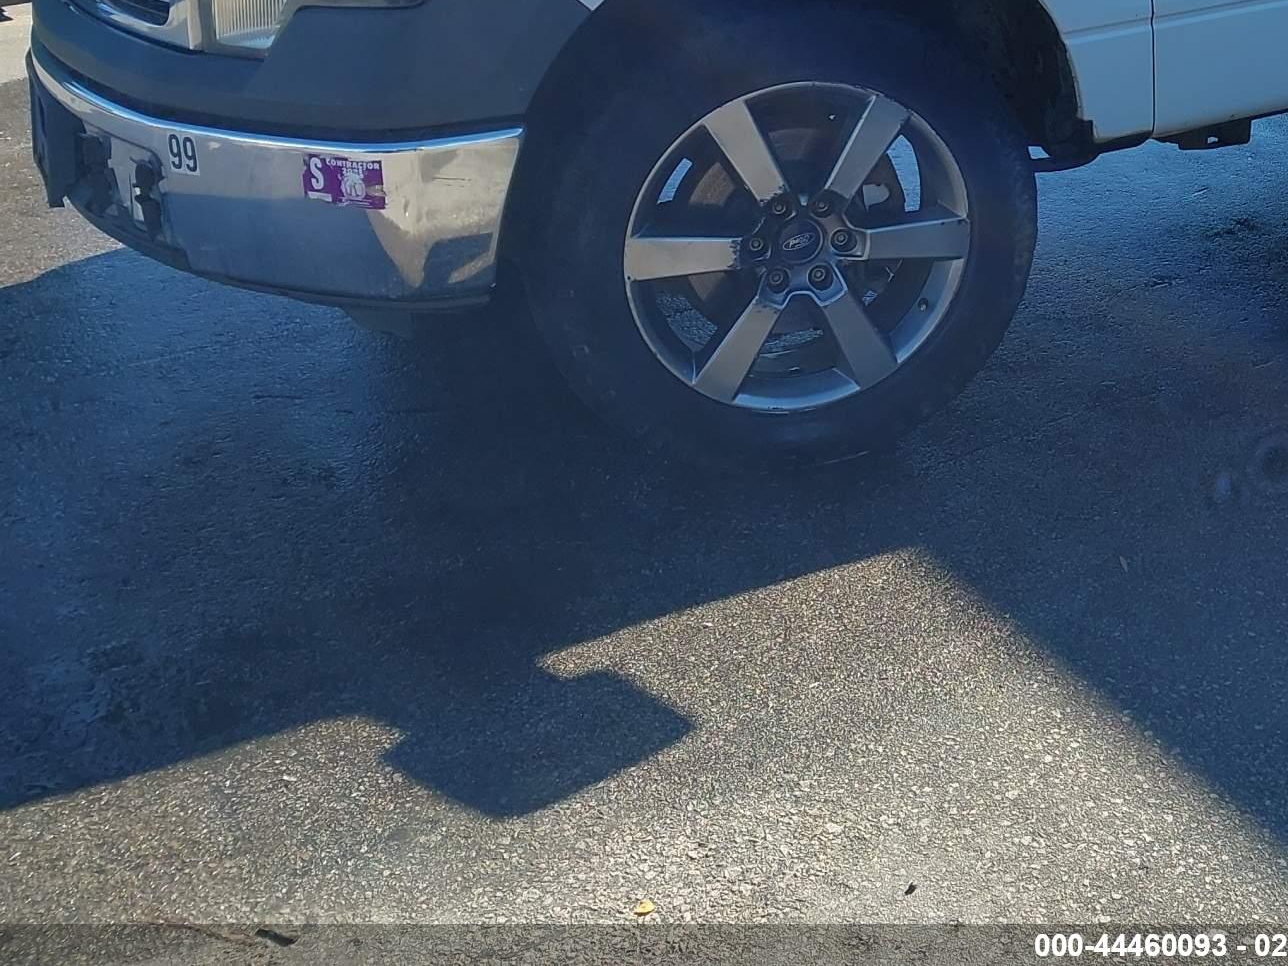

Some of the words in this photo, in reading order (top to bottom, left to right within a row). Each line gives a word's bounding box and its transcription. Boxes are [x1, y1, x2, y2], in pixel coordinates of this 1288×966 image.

[168, 133, 198, 172] 99
[325, 157, 380, 170] CONTRACTOR
[309, 156, 325, 191] S
